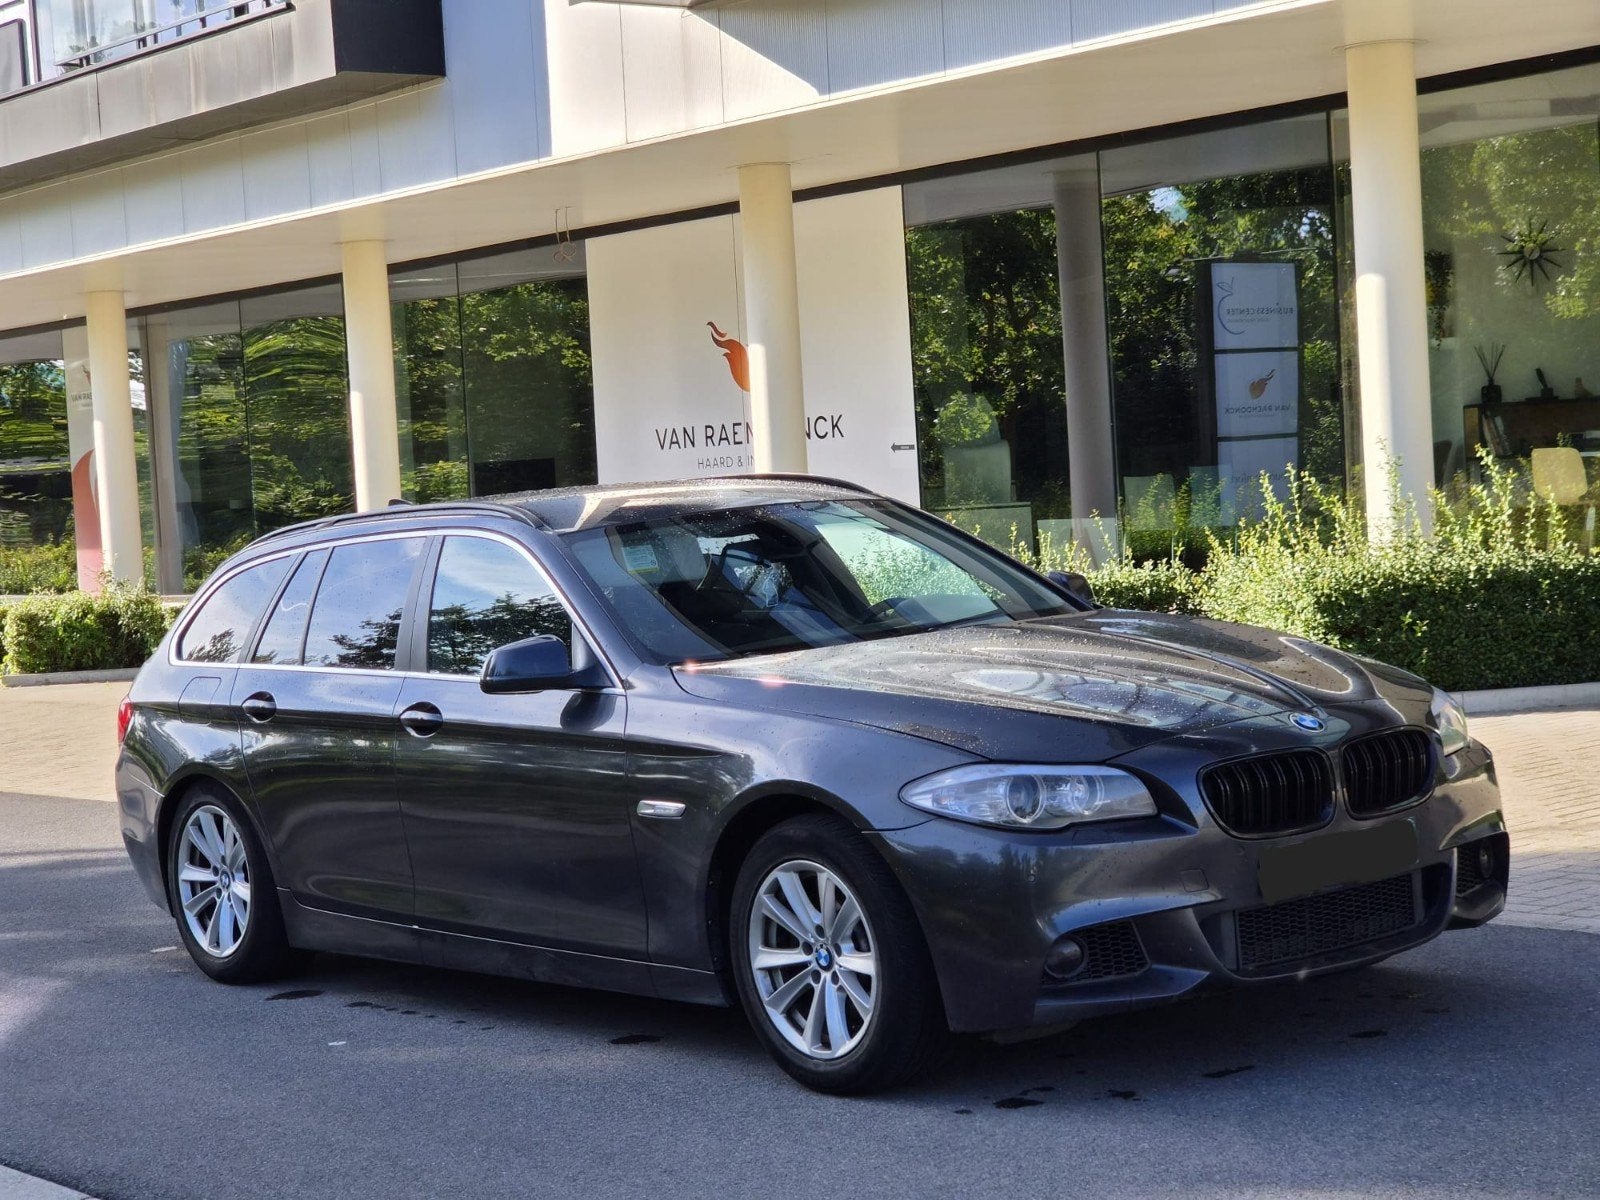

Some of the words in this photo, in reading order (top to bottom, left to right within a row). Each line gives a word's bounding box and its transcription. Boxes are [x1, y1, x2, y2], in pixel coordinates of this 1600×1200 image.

[655, 426, 695, 450] VAN
[697, 456, 734, 469] HAARD
[737, 455, 744, 468] &
